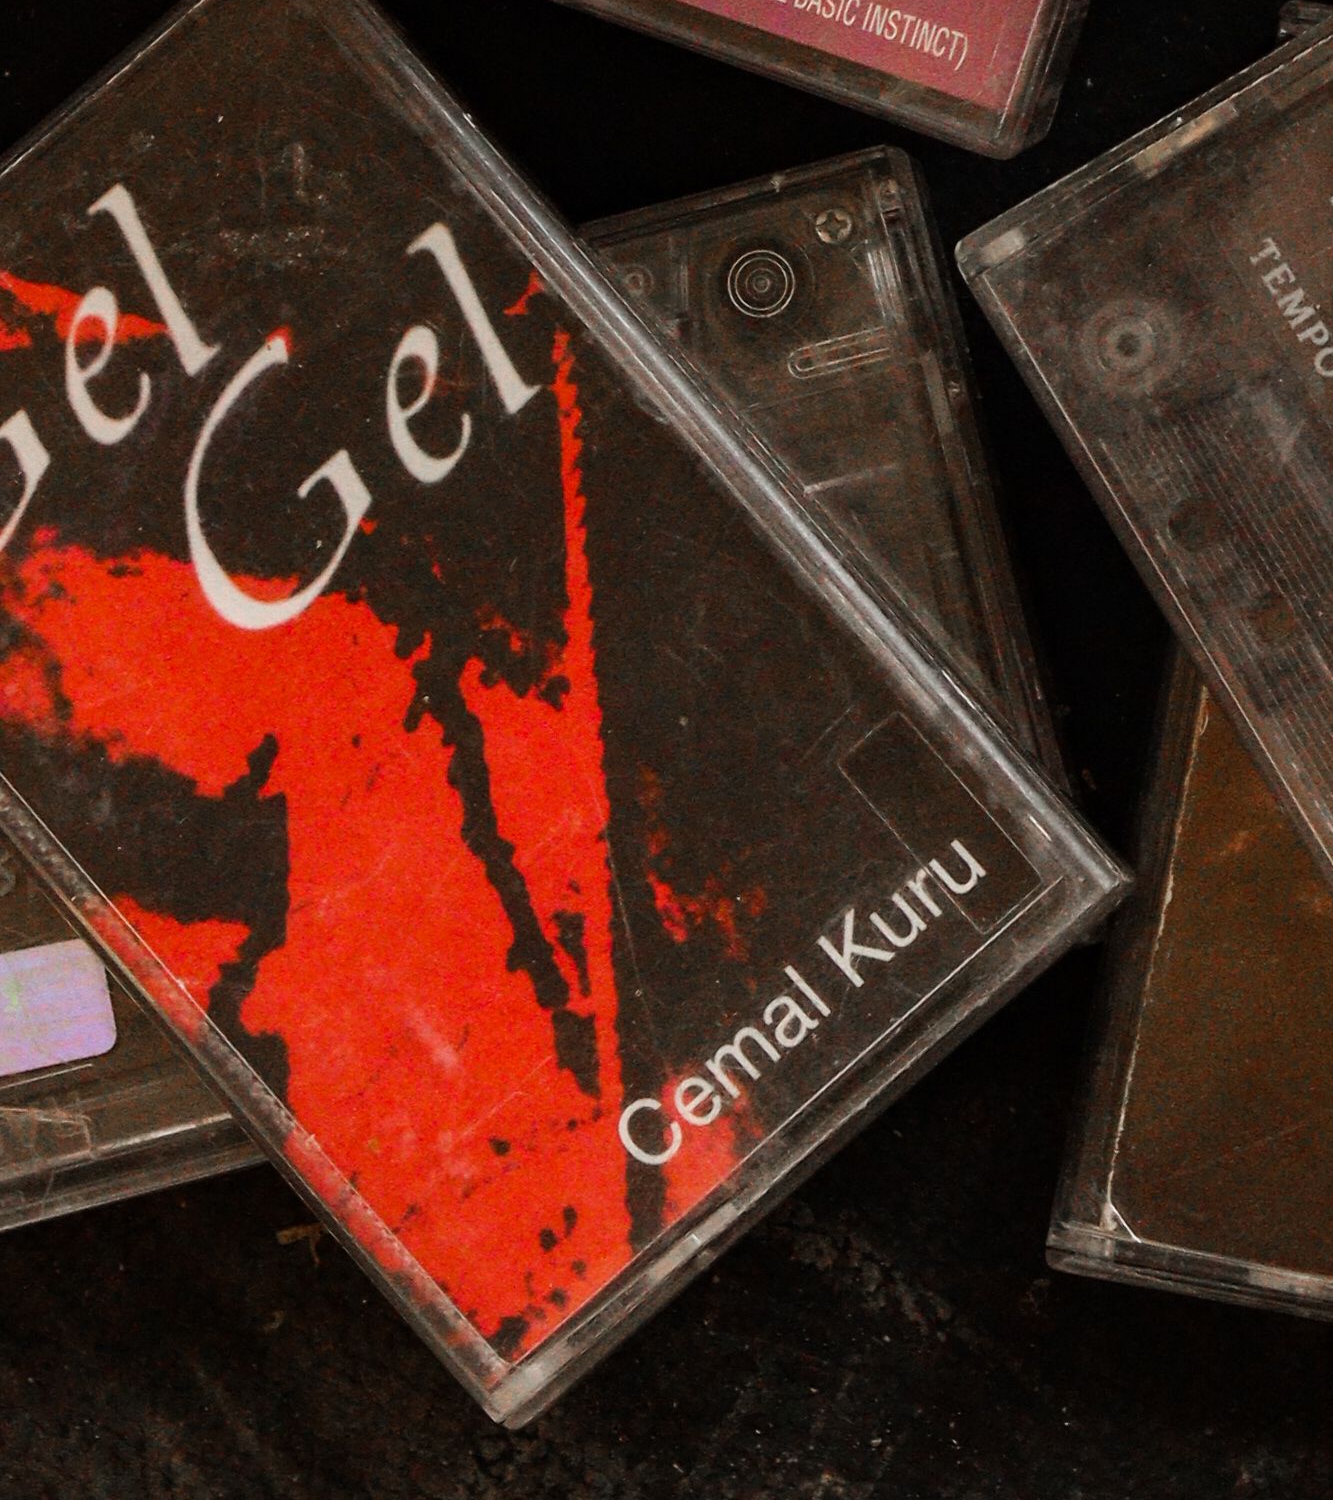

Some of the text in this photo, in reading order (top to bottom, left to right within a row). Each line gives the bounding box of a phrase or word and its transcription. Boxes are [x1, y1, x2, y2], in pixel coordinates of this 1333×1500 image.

[184, 222, 538, 631] Gel
[619, 838, 990, 1169] Cemal Kuru
